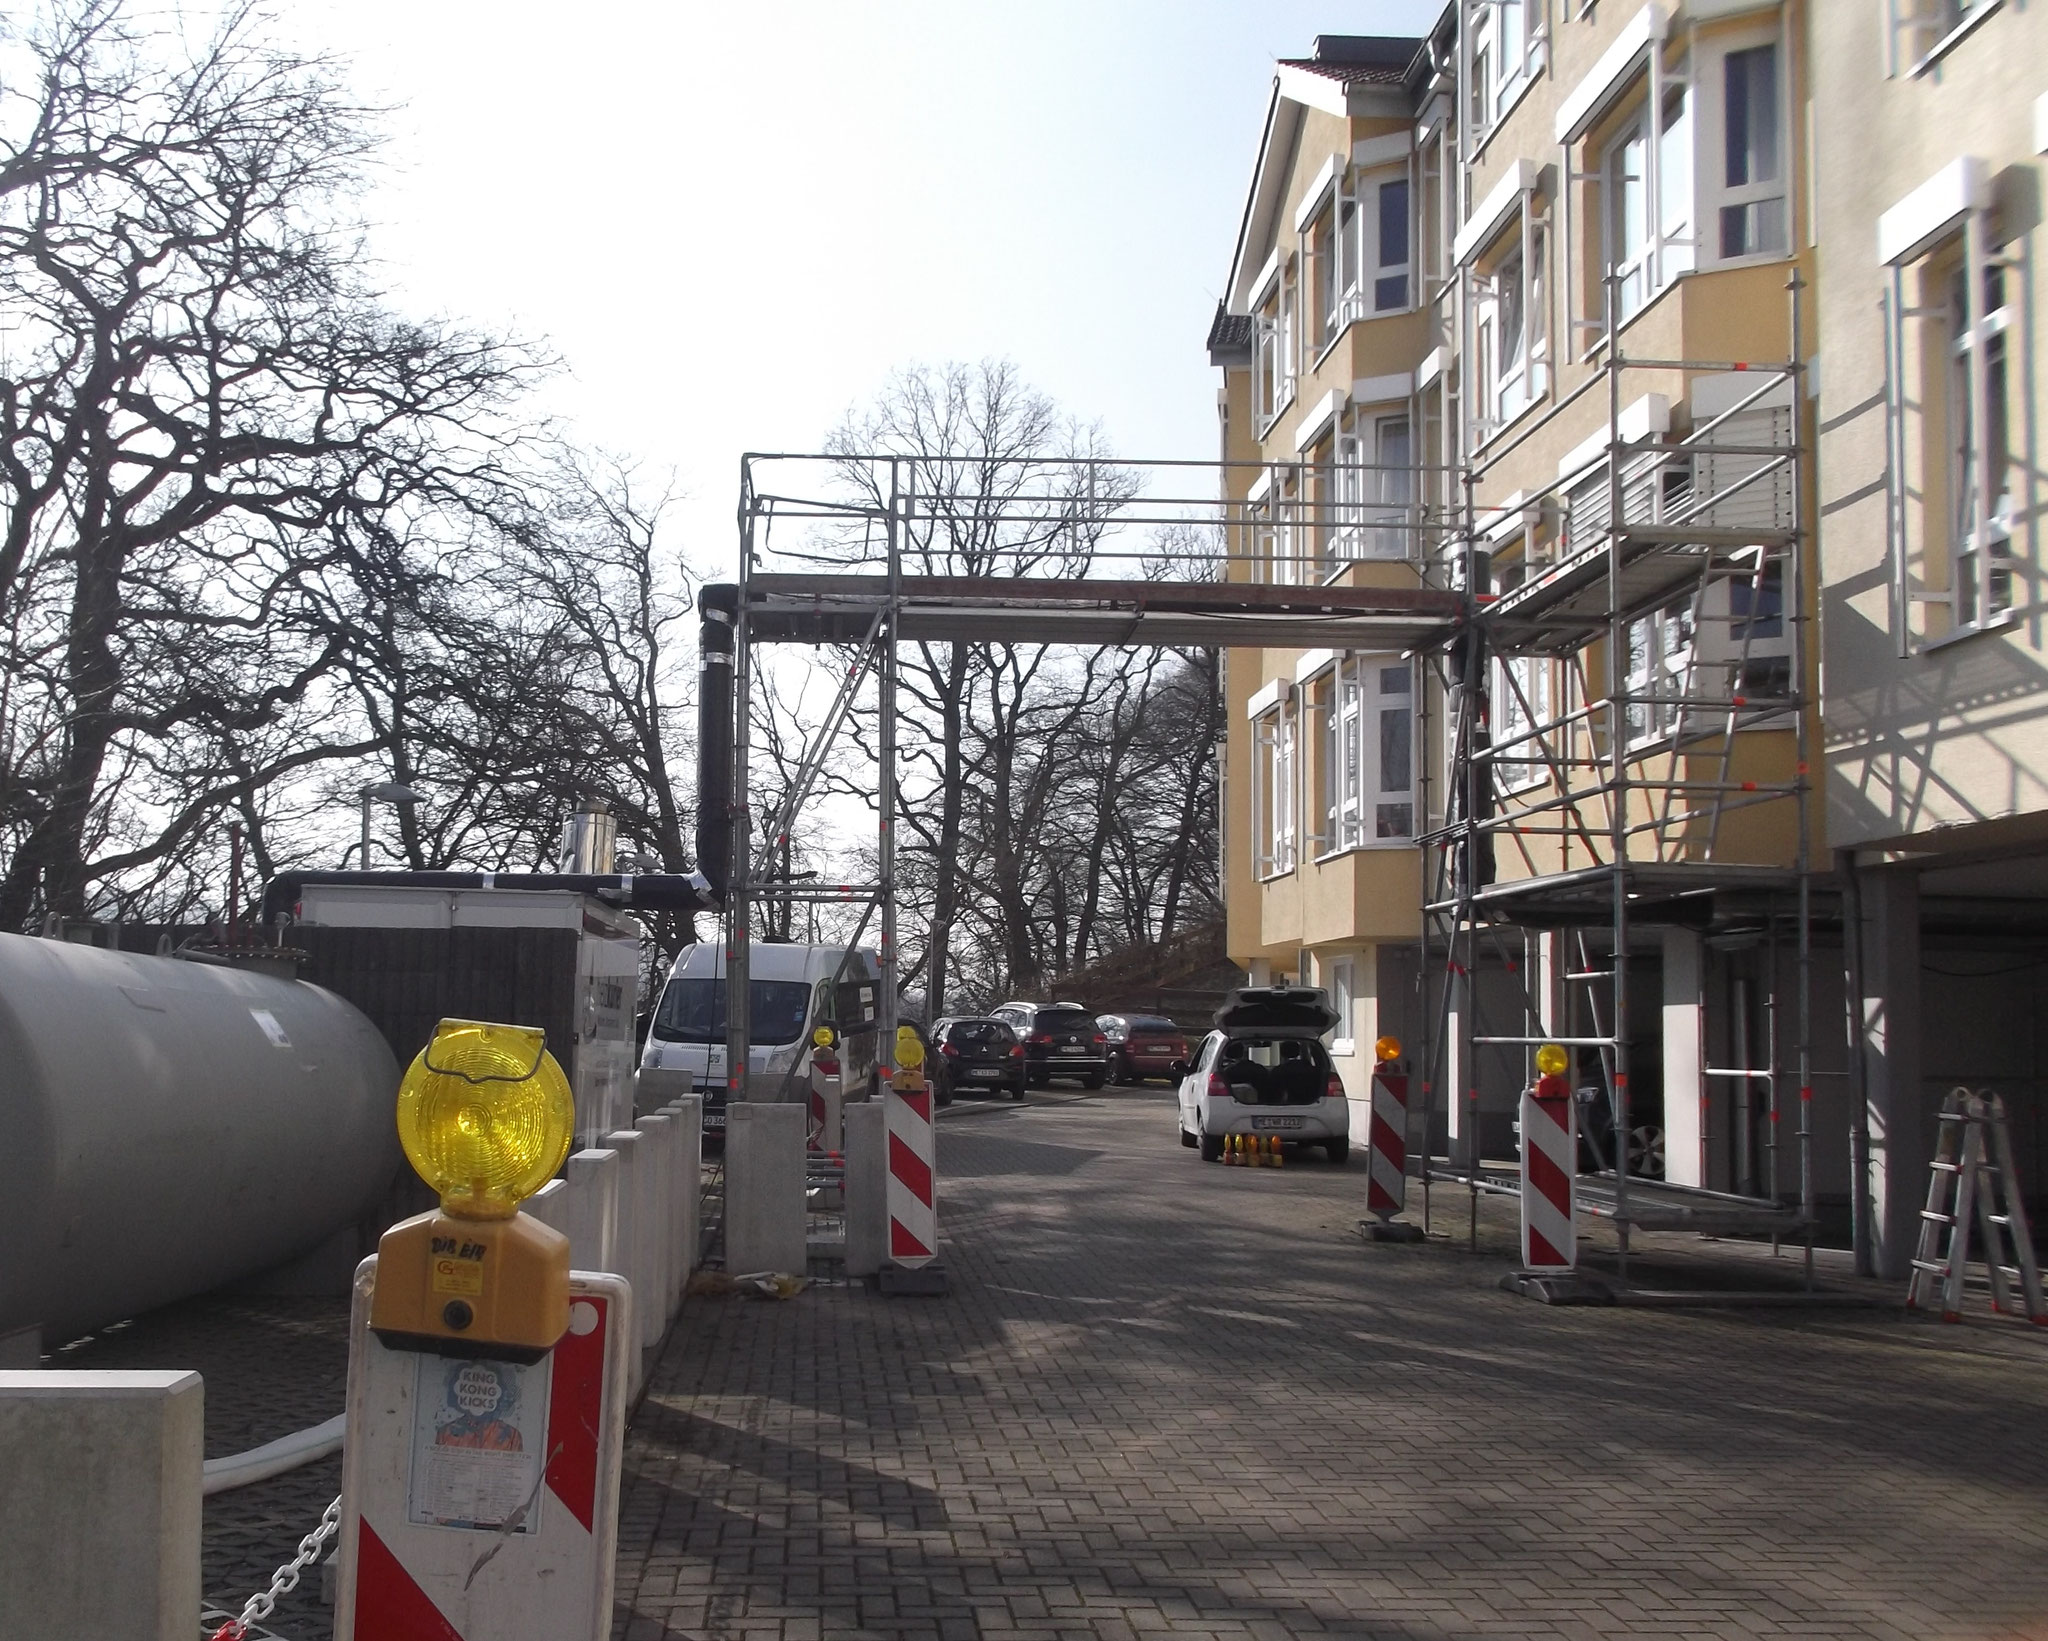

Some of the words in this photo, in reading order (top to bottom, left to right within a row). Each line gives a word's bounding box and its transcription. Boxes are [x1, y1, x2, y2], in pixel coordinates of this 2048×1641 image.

[463, 1370, 496, 1385] KING
[459, 1383, 498, 1397] KONG
[459, 1396, 496, 1410] KICKS
